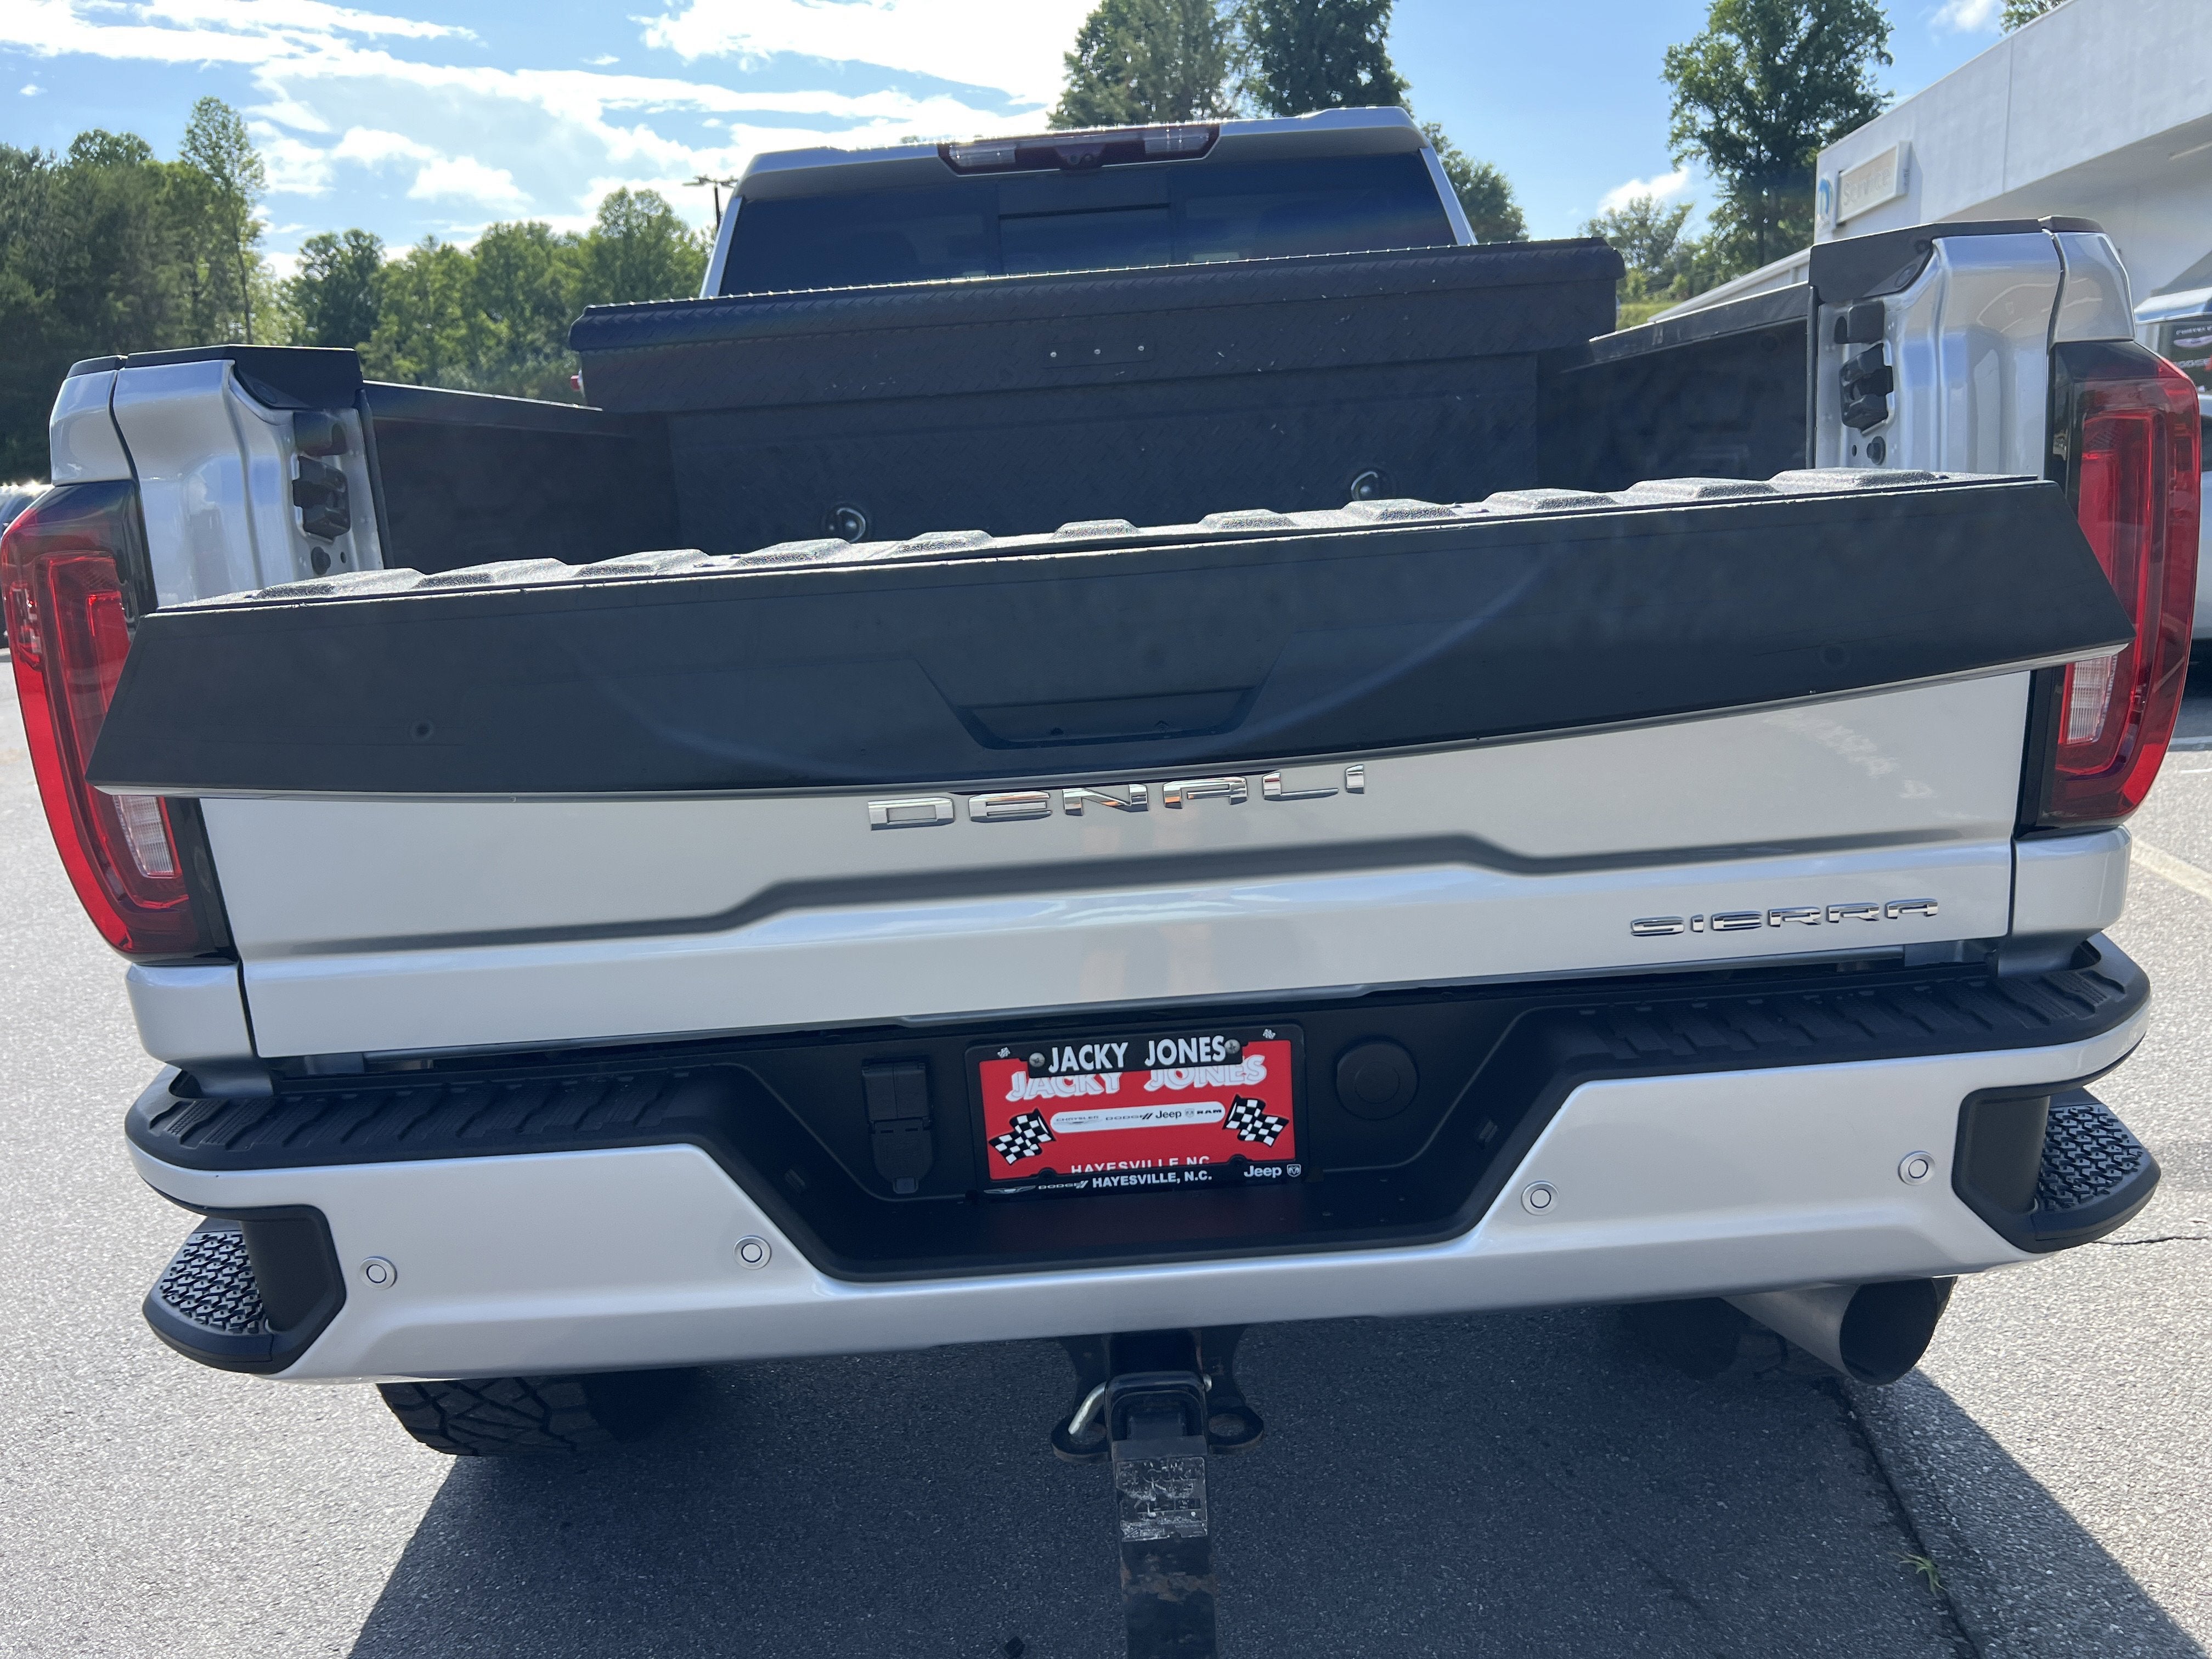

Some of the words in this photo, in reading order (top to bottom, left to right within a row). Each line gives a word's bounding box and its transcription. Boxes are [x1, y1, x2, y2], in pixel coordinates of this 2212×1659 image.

[866, 763, 1365, 831] DENALI
[1630, 898, 1939, 936] SIERRA
[1048, 1042, 1128, 1073] JACKY
[1144, 1035, 1226, 1066] JONES
[1005, 1070, 1123, 1102] JACKY
[1143, 1054, 1267, 1092] JONES
[1155, 1110, 1182, 1119] Jeep
[1092, 1172, 1181, 1188] HAYESVILLE,
[1184, 1170, 1212, 1182] N.C.
[1243, 1165, 1283, 1179] Jeep
